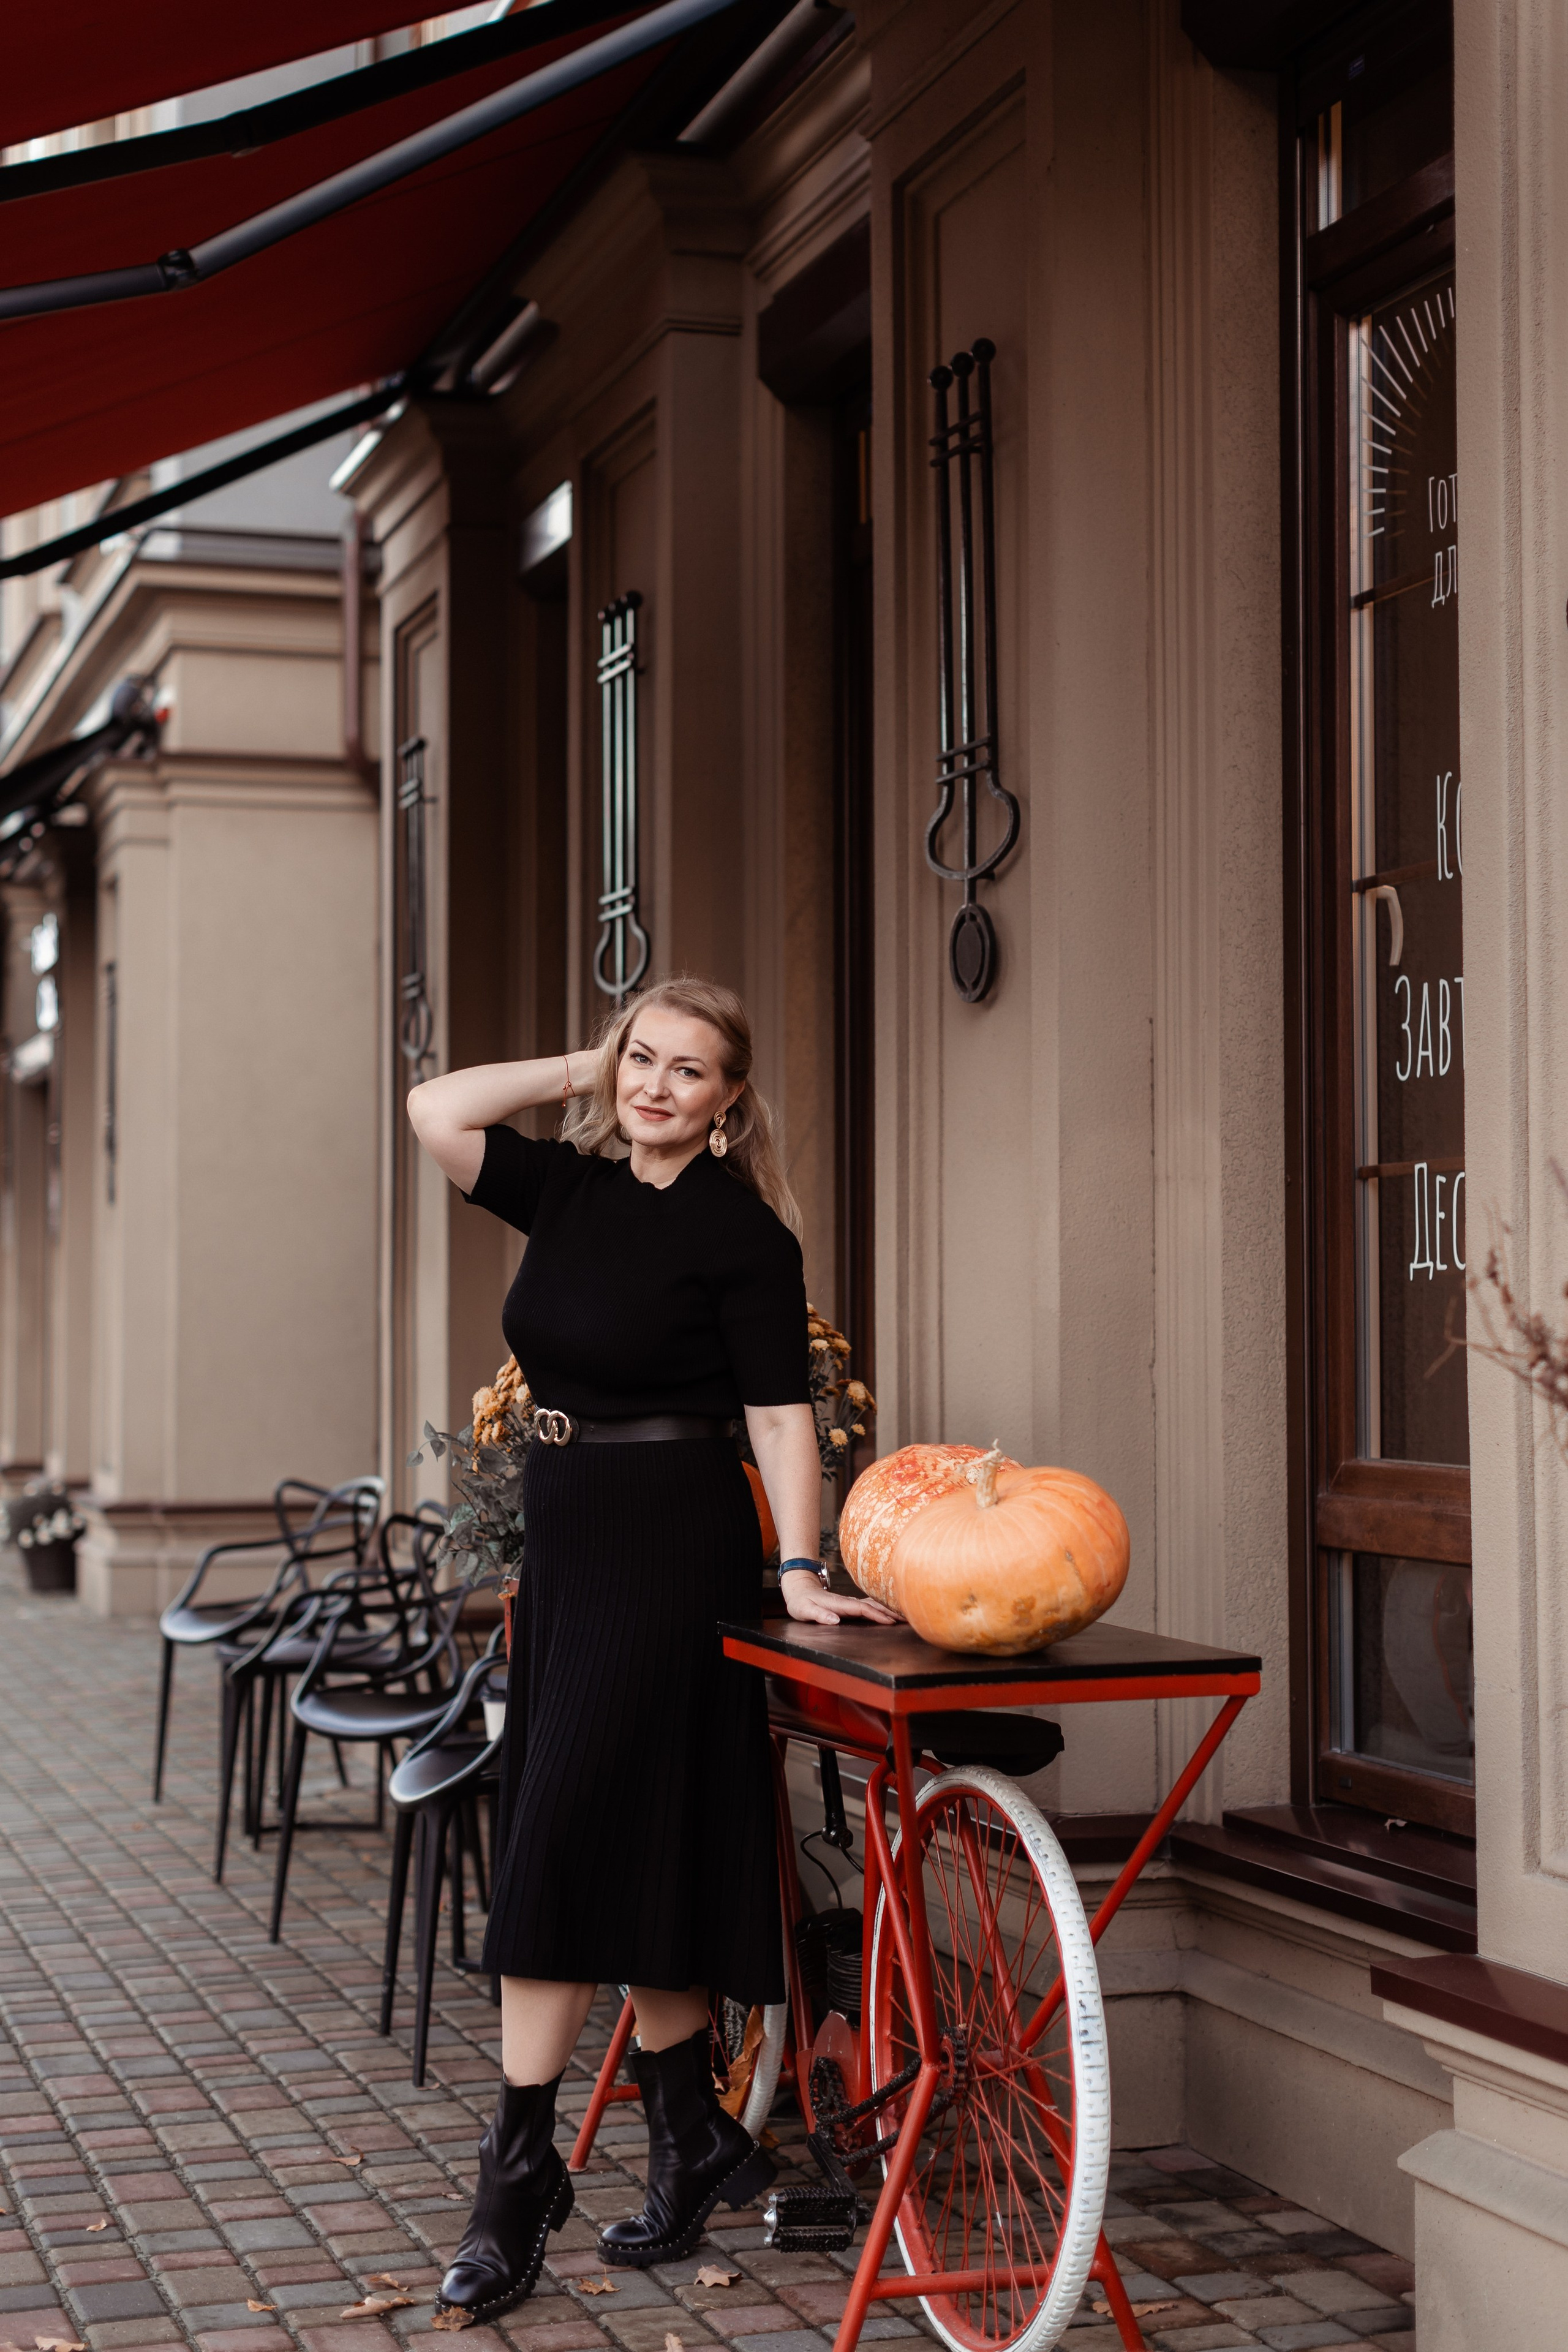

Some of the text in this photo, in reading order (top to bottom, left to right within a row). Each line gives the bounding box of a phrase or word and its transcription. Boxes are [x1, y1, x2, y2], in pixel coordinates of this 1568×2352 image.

[1428, 473, 1458, 533] ГОТ
[1431, 545, 1457, 609] ДЛ
[1410, 1162, 1466, 1281] ДЕС
